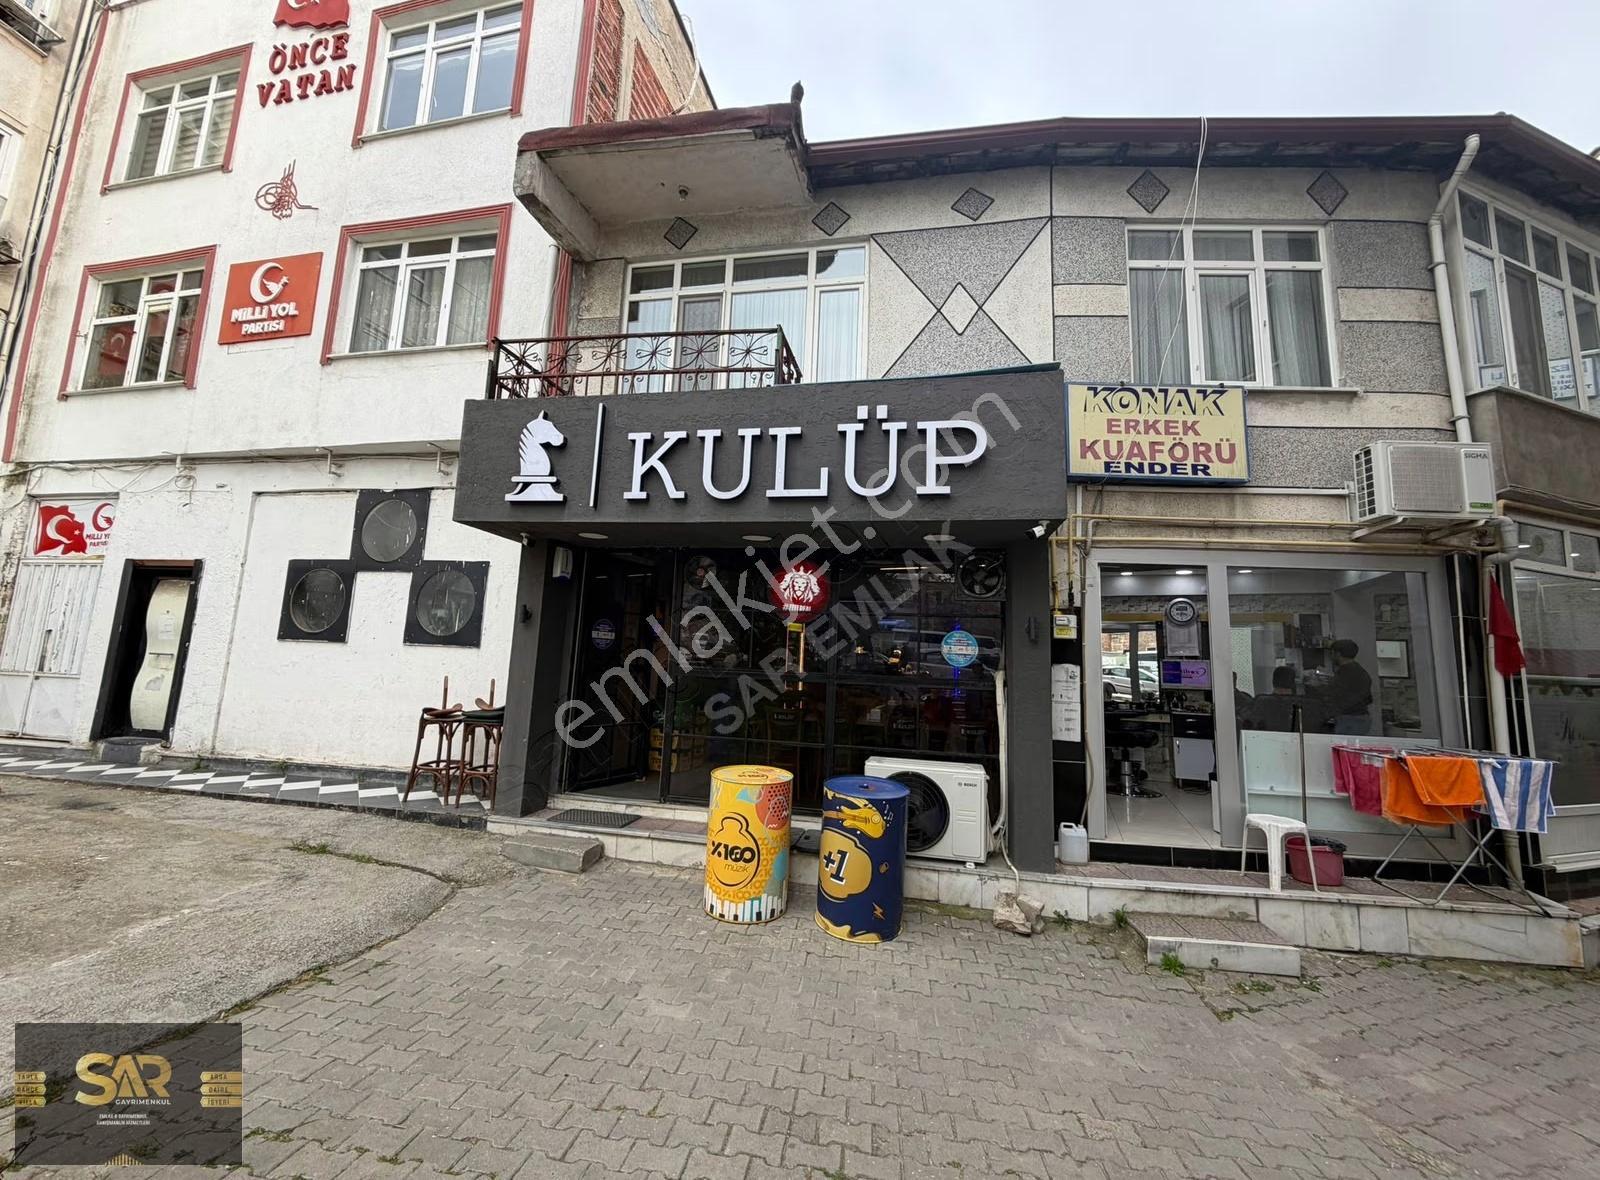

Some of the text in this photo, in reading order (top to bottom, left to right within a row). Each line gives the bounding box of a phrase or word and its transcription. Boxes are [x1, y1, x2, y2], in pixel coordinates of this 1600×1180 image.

[269, 32, 349, 75] ÖNCE
[256, 63, 357, 108] VATAN
[270, 302, 299, 317] YOL
[1083, 386, 1229, 416] KONAK
[1106, 418, 1202, 436] ERKEK
[623, 405, 988, 500] KULÜP
[1079, 437, 1237, 464] KUAFÖRÜ
[1103, 461, 1212, 476] ENDER
[724, 863, 750, 873] müzik
[823, 849, 850, 885] +1
